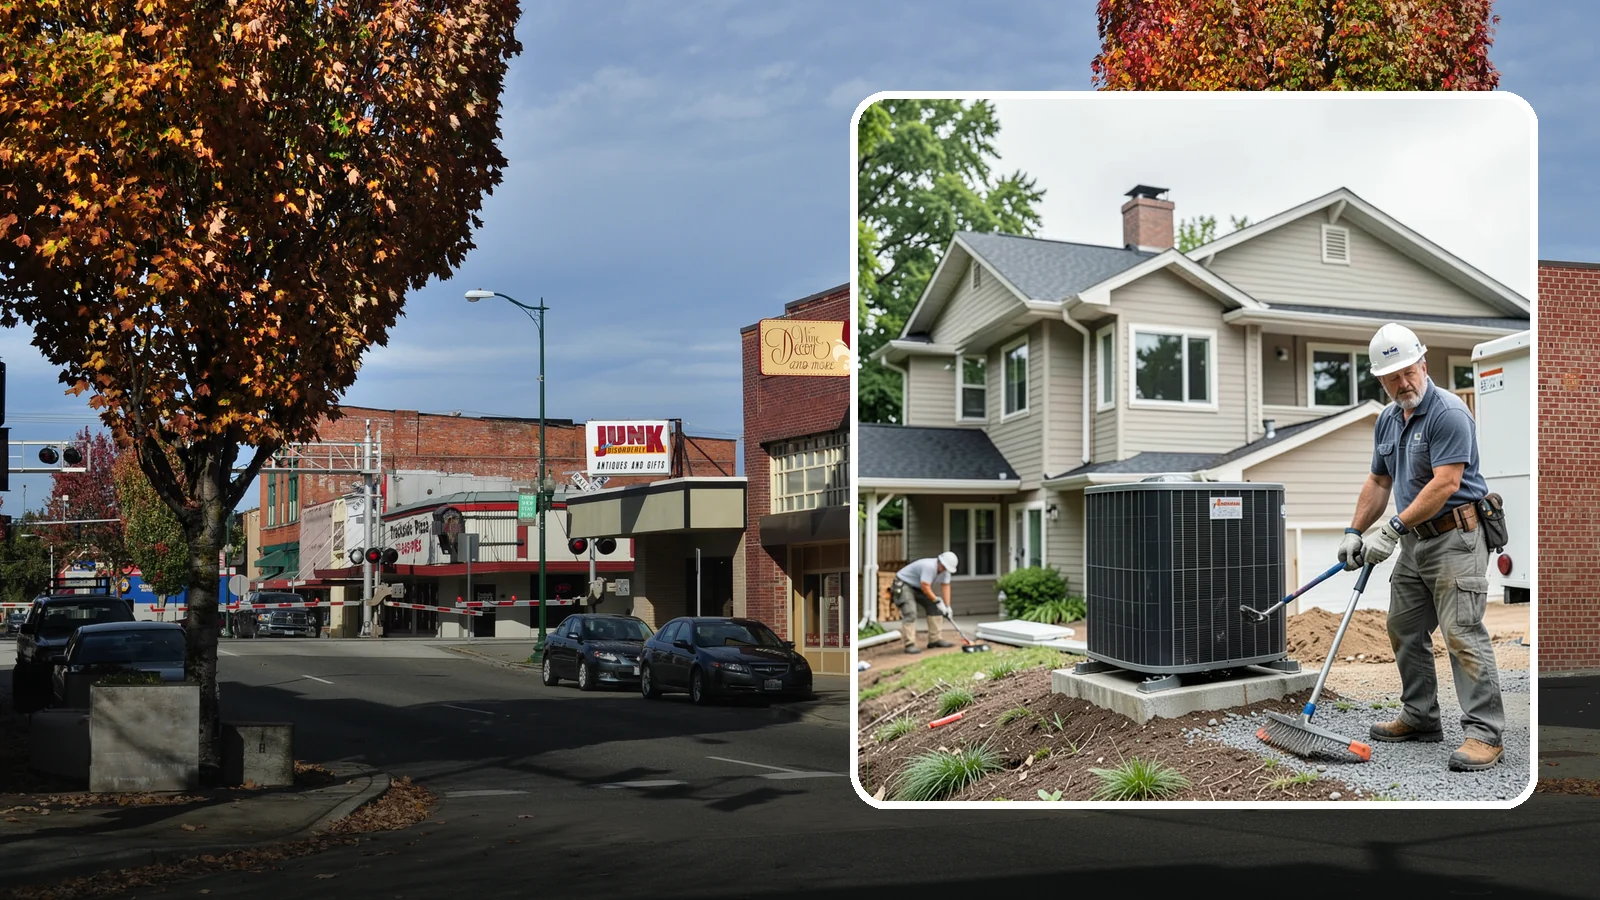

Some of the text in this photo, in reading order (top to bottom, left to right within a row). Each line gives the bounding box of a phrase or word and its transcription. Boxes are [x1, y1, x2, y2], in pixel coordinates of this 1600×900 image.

[595, 425, 665, 457] JUNK
[607, 446, 646, 454] DISORDERLY
[597, 461, 665, 470] ANTIQUES AND GIFTS
[414, 520, 429, 535] Pizza
